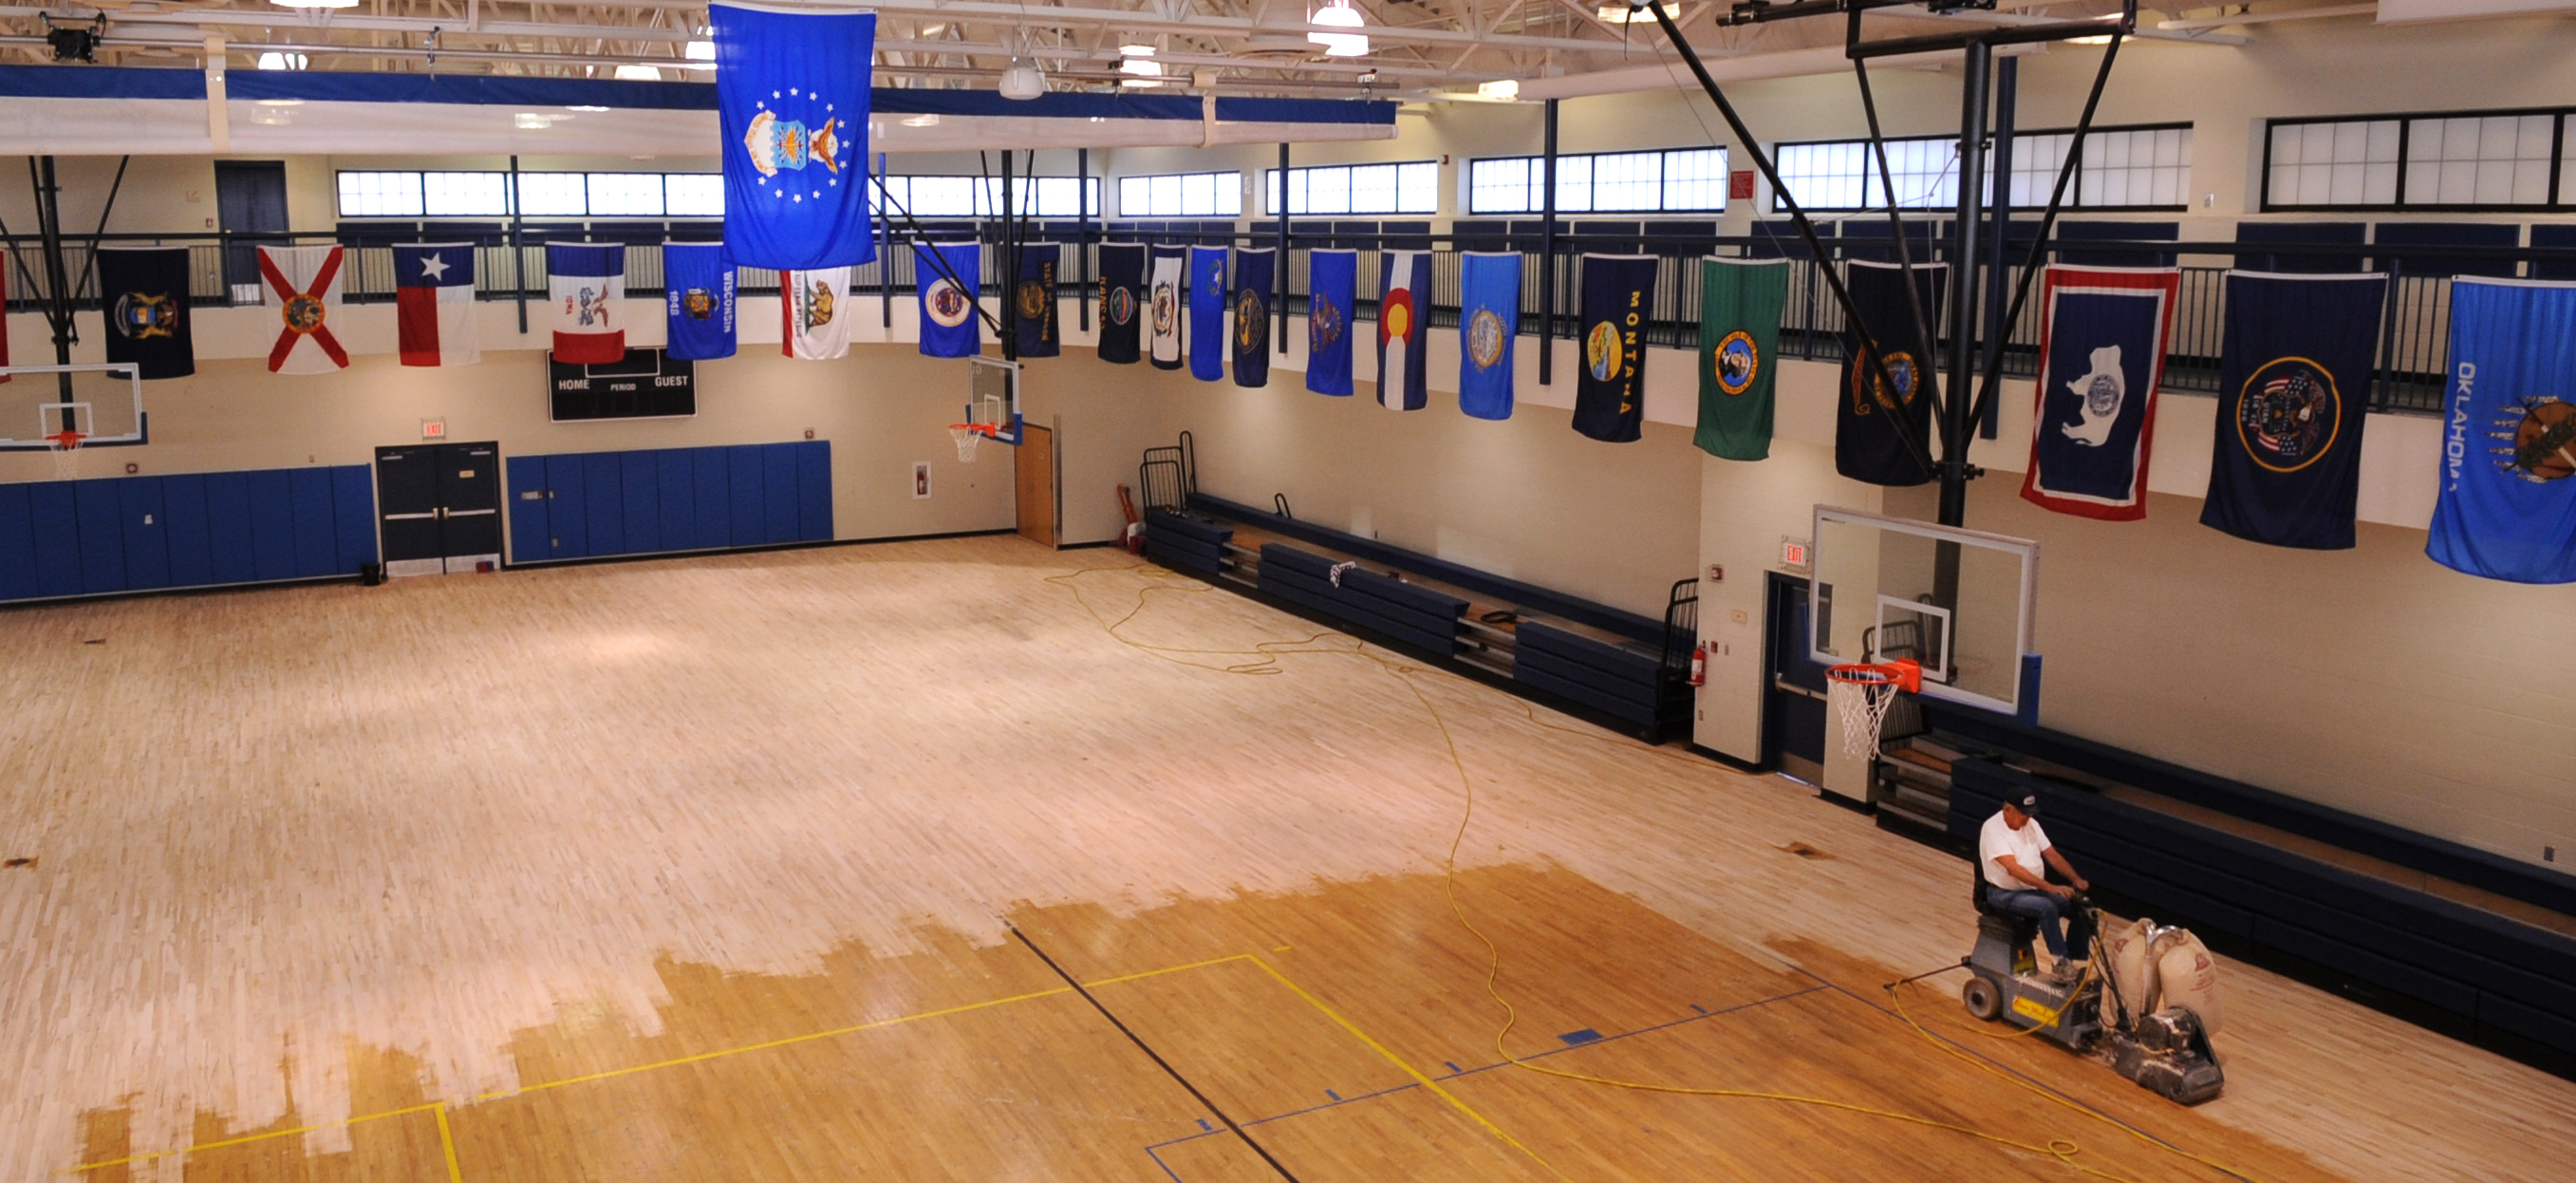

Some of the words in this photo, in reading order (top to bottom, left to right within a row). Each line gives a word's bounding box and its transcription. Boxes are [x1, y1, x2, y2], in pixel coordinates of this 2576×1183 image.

[669, 290, 680, 315] 1848
[723, 271, 734, 333] WISCONSIN
[1619, 291, 1641, 415] MONTANA
[558, 379, 590, 390] HOME
[610, 383, 637, 391] PERIOD
[655, 375, 688, 387] GUEST
[426, 423, 440, 436] EXIT
[1787, 545, 1802, 562] EXIT
